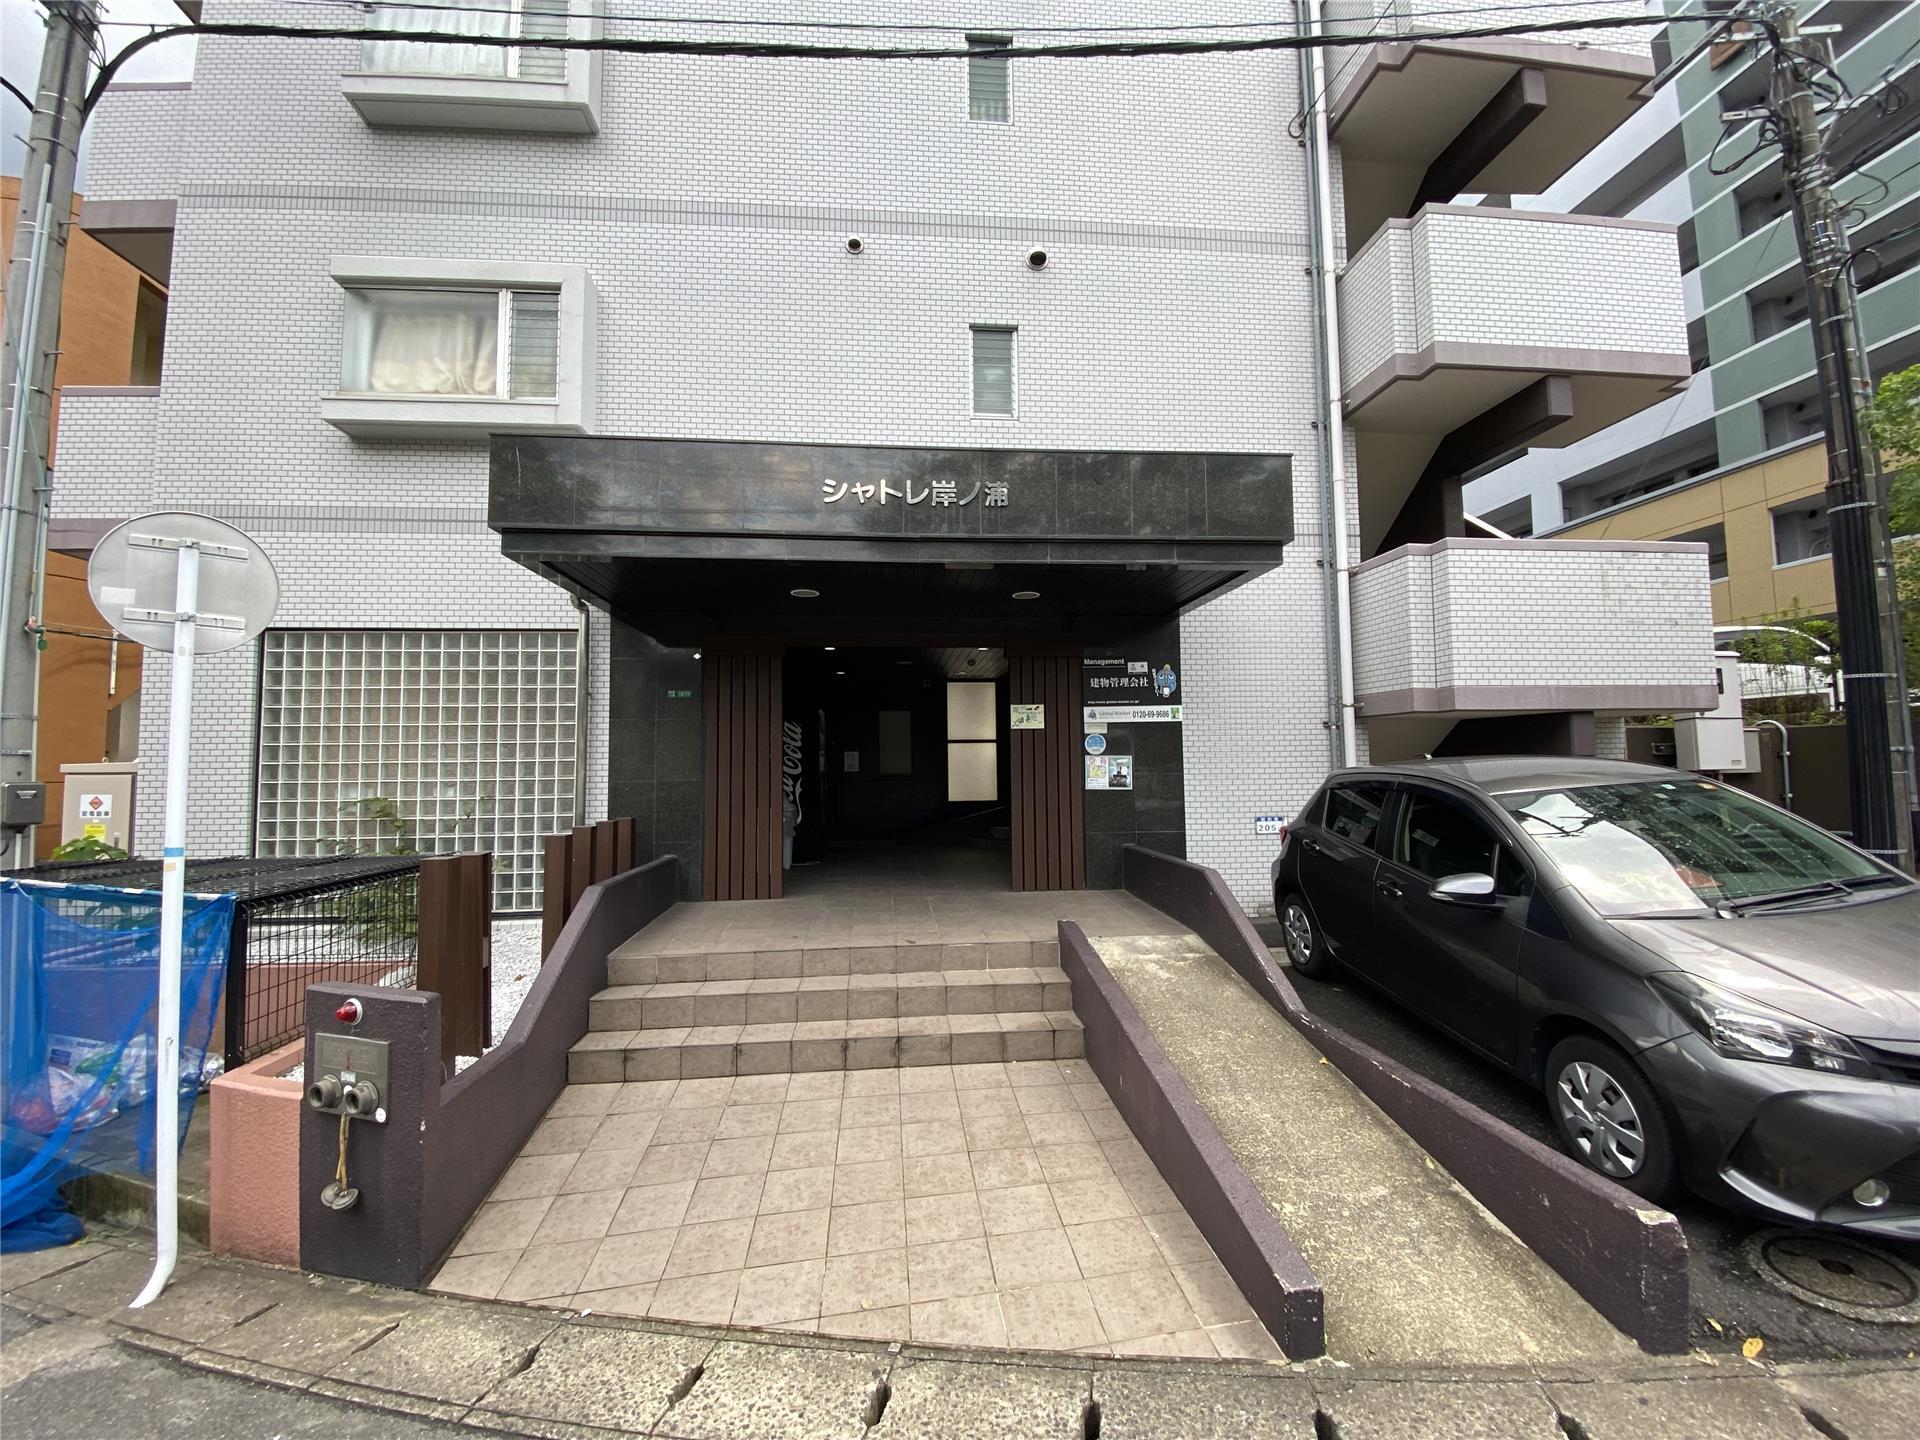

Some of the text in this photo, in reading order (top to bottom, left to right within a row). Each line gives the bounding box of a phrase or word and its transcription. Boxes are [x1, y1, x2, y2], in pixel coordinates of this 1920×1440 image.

[822, 478, 1010, 508] シャトレ岸ノ浦
[1084, 658, 1125, 666] Management
[1090, 677, 1149, 688] 建物管理会社
